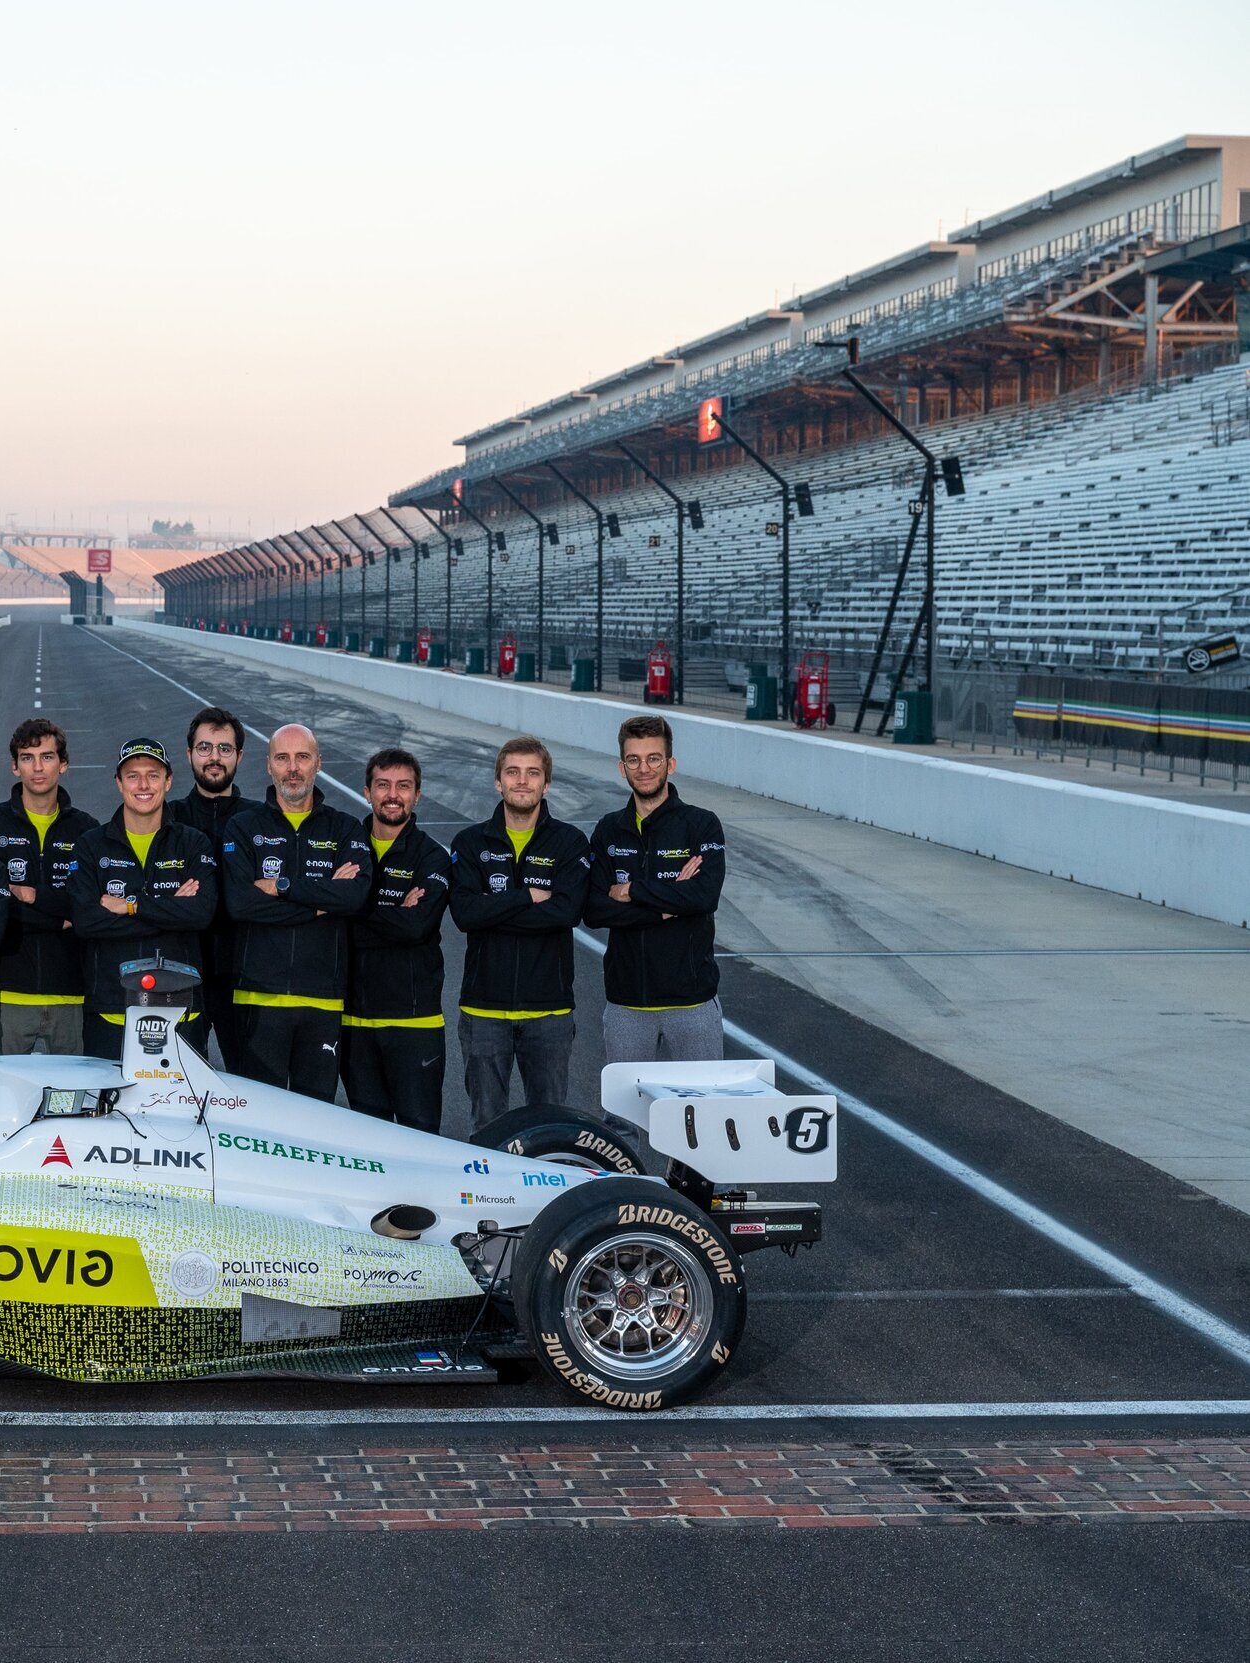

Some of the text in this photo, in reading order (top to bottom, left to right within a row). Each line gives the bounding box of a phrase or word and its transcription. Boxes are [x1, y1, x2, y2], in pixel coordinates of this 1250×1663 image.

[909, 502, 922, 513] 19
[767, 524, 778, 533] 20
[137, 1020, 169, 1032] INDY
[134, 1069, 183, 1079] dallara
[210, 1095, 248, 1109] eagle
[795, 1112, 824, 1149] 5
[83, 1145, 207, 1171] ADLINK
[217, 1132, 386, 1174] SCHAEFFLER
[463, 1158, 490, 1175] rti
[522, 1172, 567, 1187] intel
[475, 1195, 516, 1204] Microsoft
[617, 1204, 737, 1285] BRIDGESTONE
[222, 1261, 320, 1274] POLITECNICO
[222, 1277, 289, 1287] MILANO 1863
[541, 1332, 662, 1409] BRIDGESTONE
